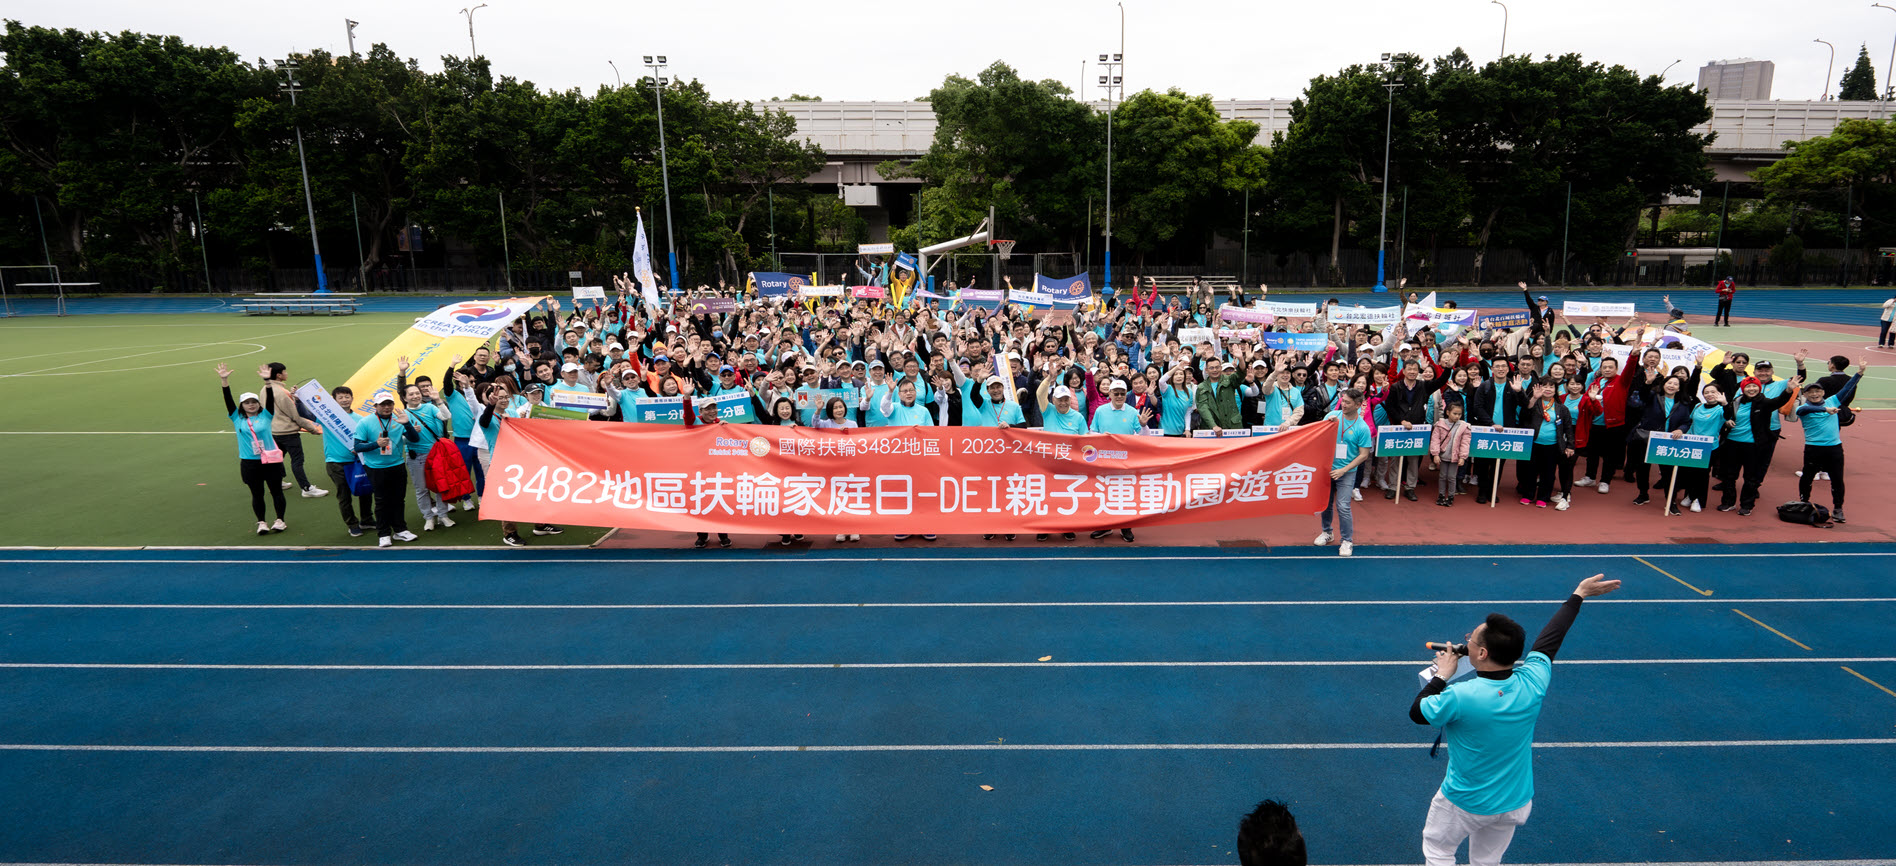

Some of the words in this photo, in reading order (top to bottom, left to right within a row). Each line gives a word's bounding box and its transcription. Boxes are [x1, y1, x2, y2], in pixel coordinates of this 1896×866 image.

[761, 280, 788, 289] Rotary
[1041, 284, 1068, 296] Rotary
[430, 325, 449, 333] the
[716, 437, 748, 449] Rotary
[778, 436, 941, 457] 國際扶輪3482地區
[961, 438, 1073, 461] 2023-24年度
[1384, 437, 1425, 450] 第七分區
[1476, 438, 1525, 453] 第八分區
[1655, 444, 1704, 460] 第九分區
[497, 461, 1317, 517] 3482地區扶輪家庭日-DEI親子運動園遊會
